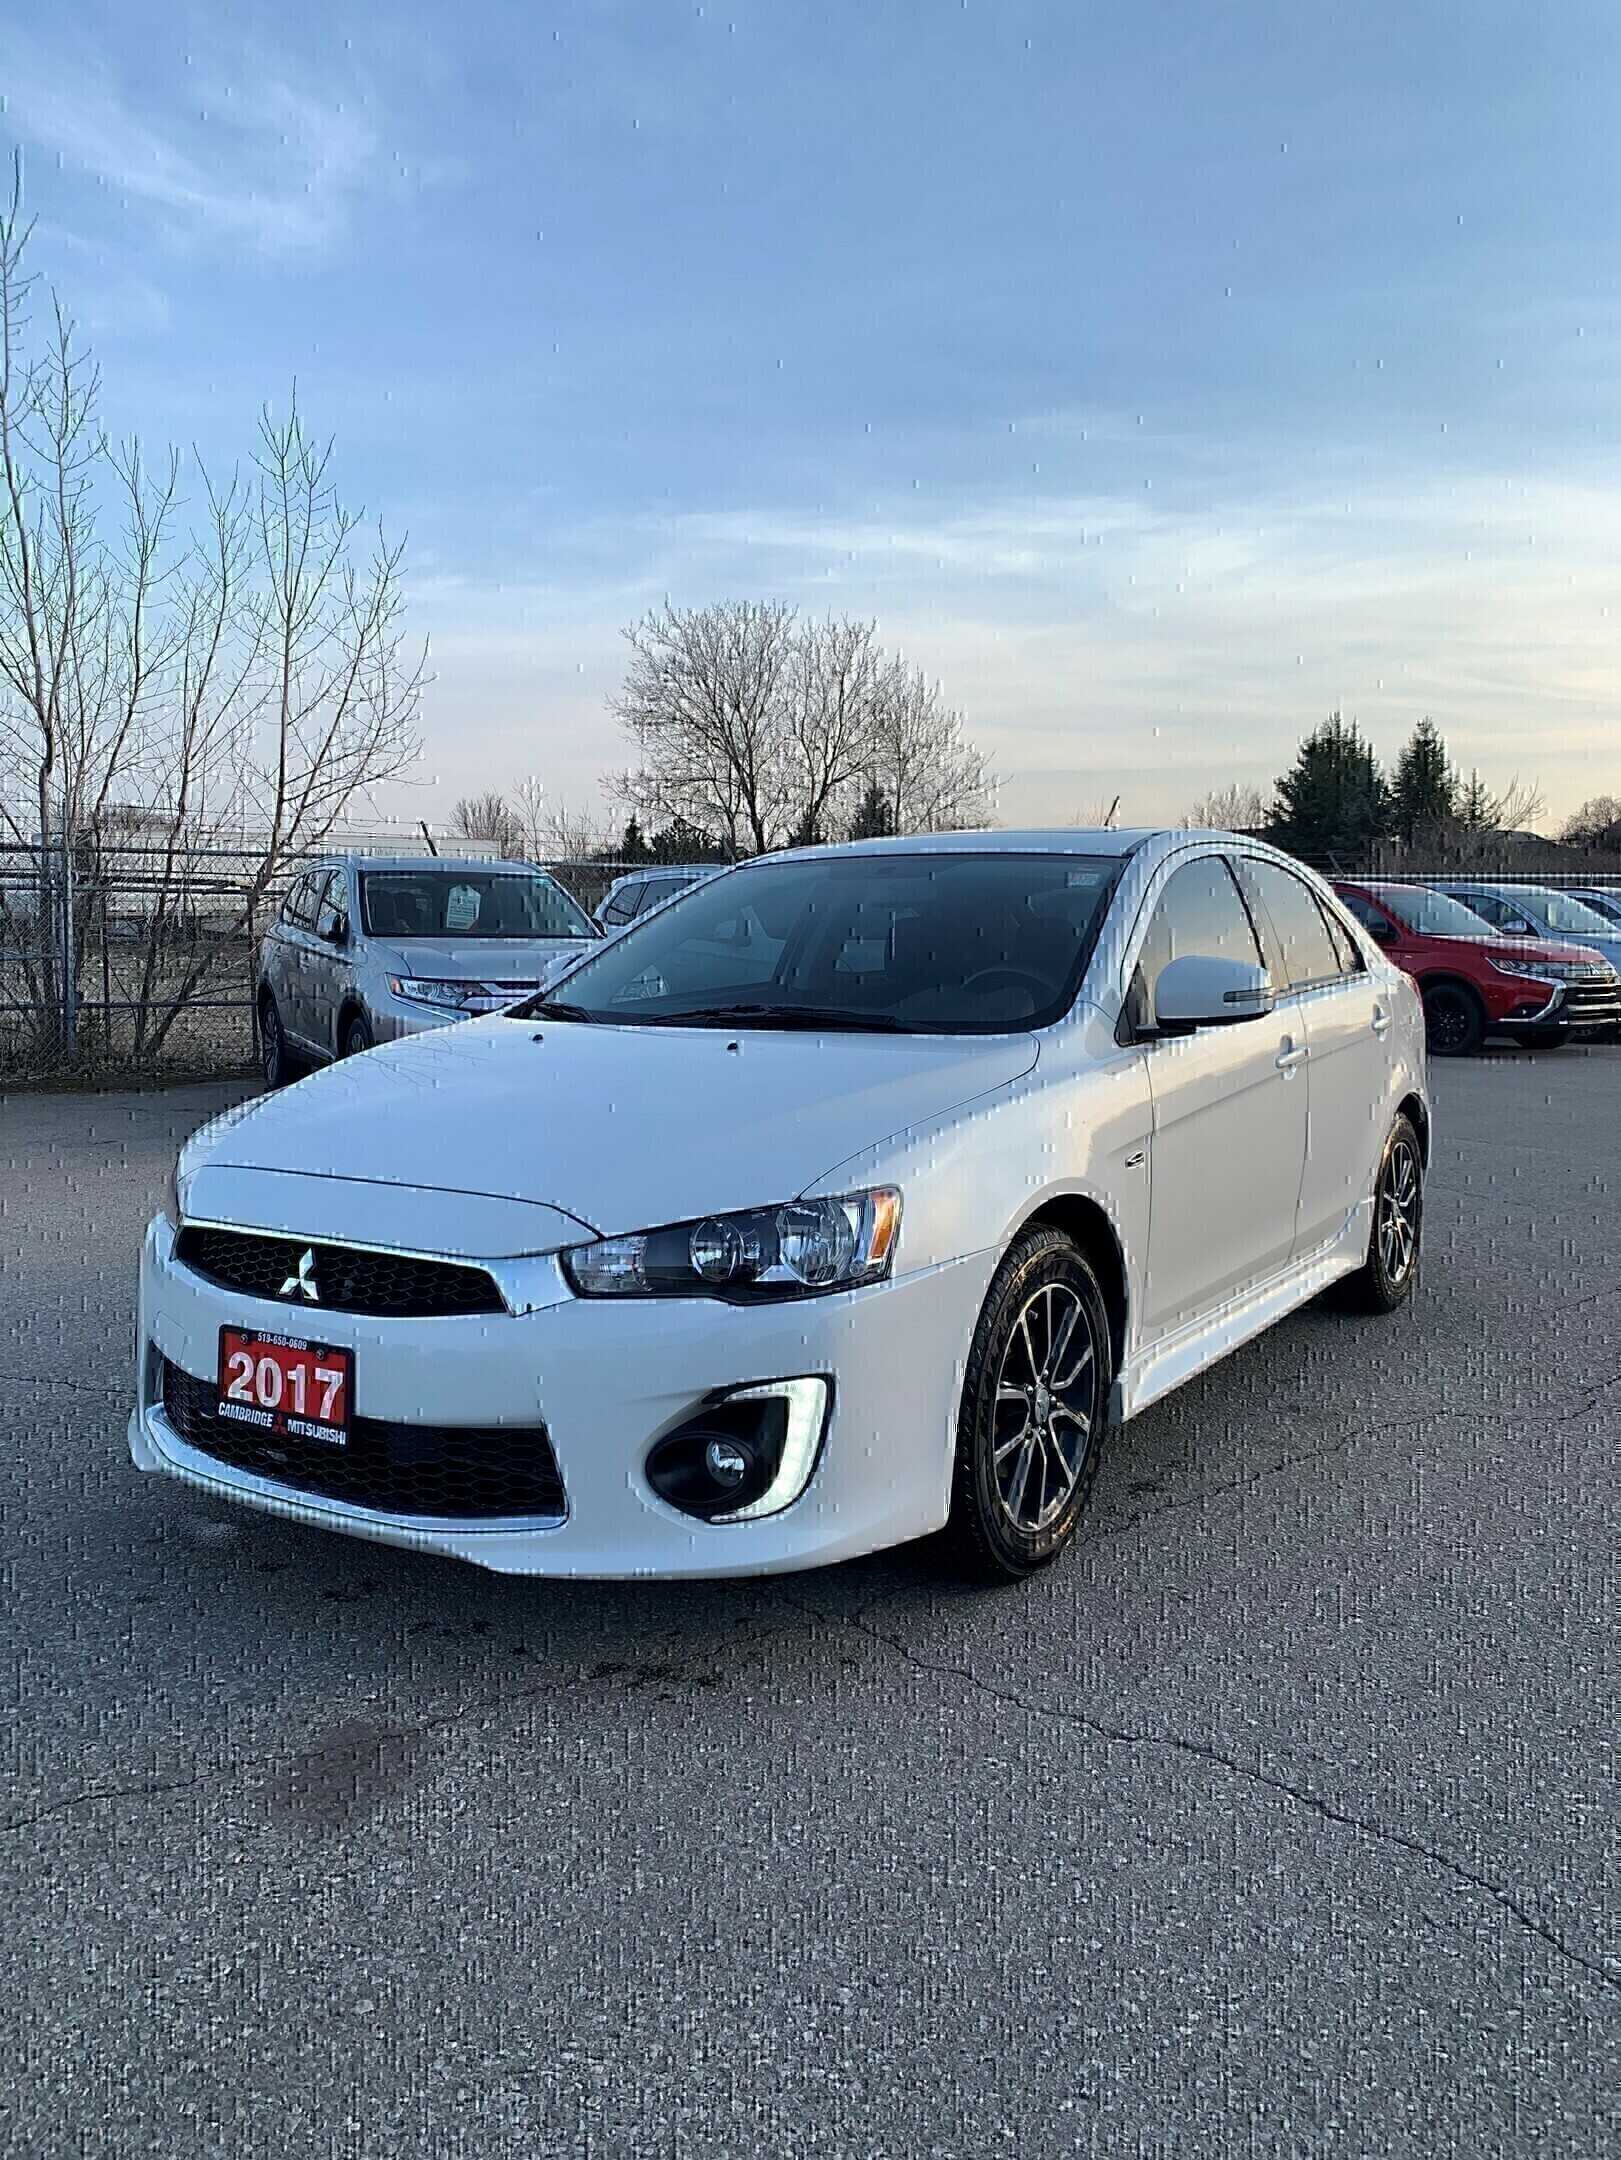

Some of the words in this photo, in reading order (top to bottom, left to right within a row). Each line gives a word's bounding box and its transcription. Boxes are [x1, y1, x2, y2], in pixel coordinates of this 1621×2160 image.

[257, 1332, 308, 1351] 519-650-0609
[227, 1351, 344, 1419] 2017
[218, 1401, 274, 1427] CAMBRIDGE
[287, 1419, 347, 1445] MITSUBISHI
